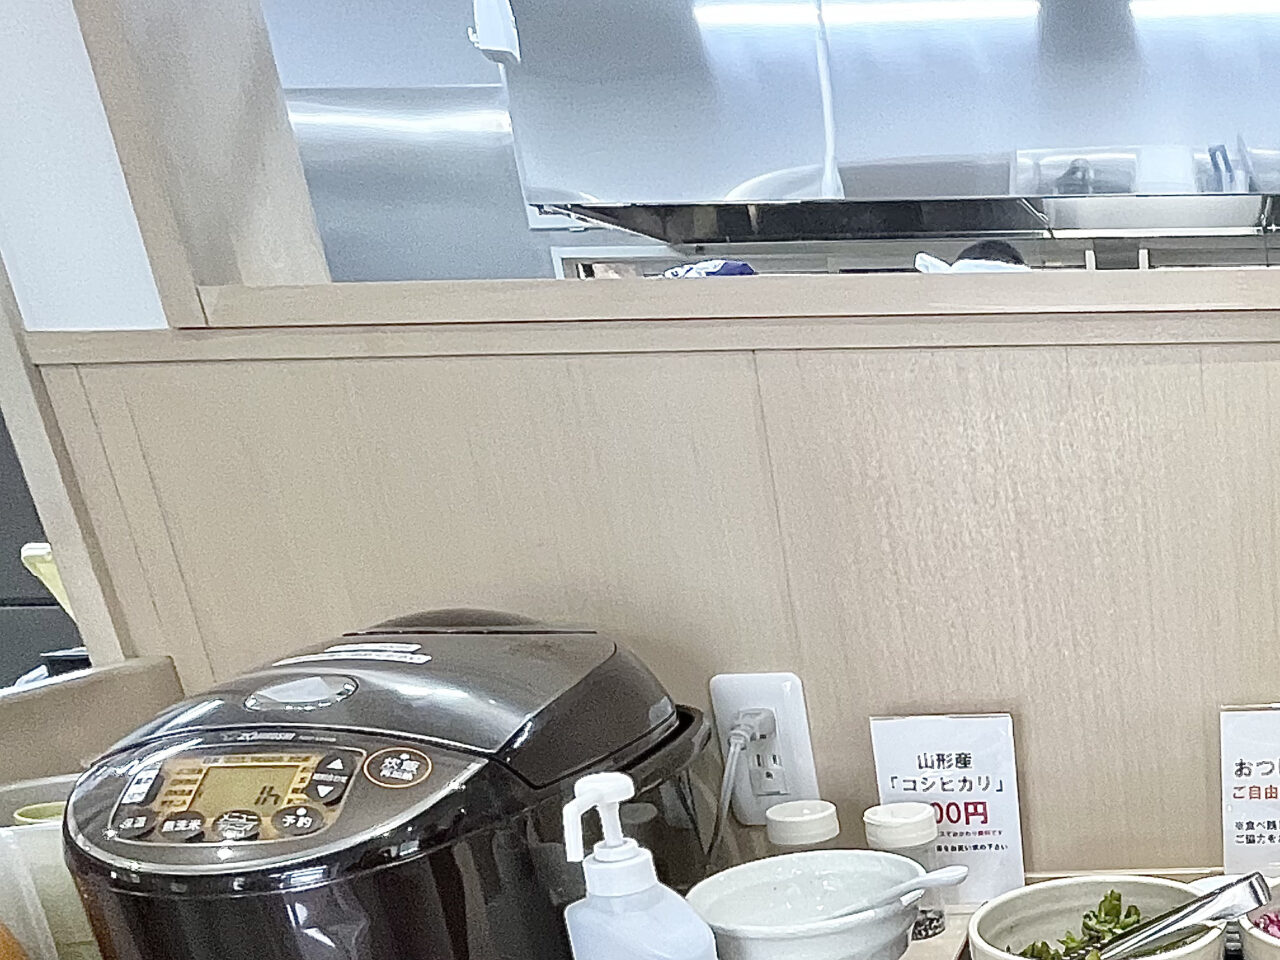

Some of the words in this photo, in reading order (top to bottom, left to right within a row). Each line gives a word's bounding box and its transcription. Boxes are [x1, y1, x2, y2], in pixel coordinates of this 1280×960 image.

[917, 752, 972, 770] 山形産
[891, 776, 1004, 793] 「コシヒカリ」
[282, 815, 313, 828] 予約
[930, 802, 988, 825] 00円
